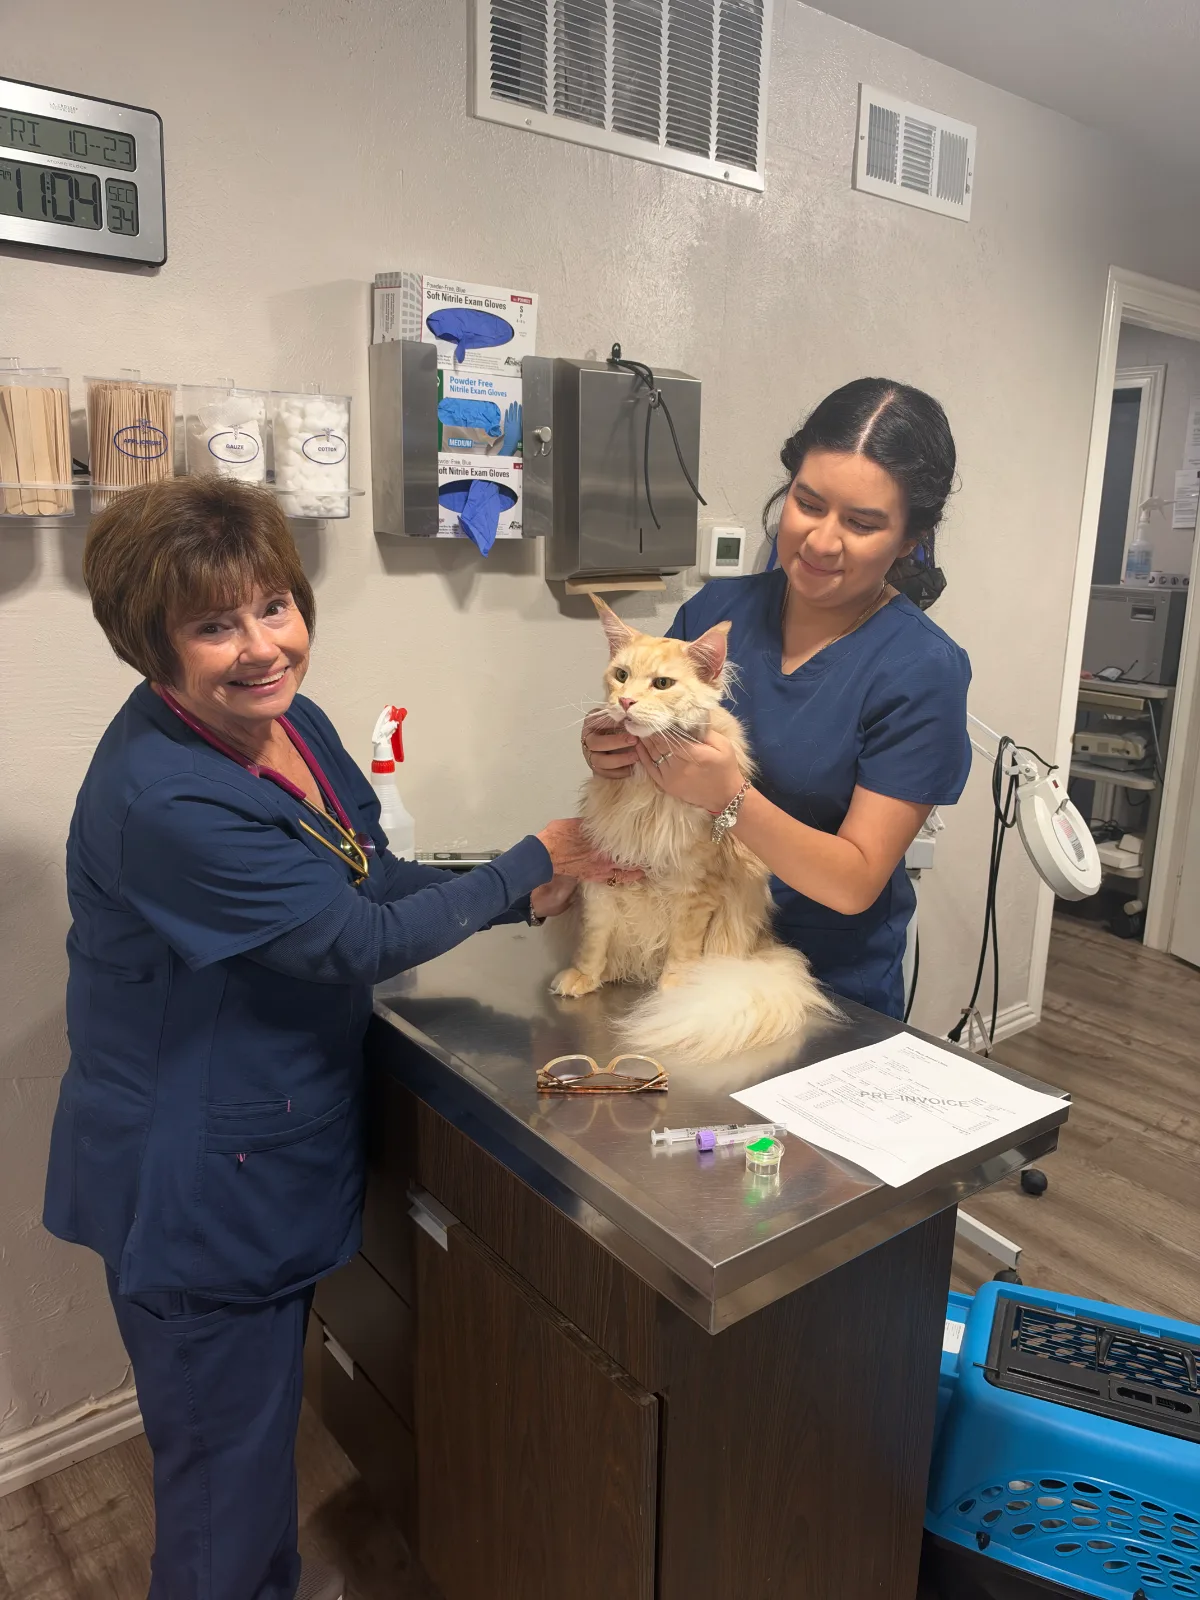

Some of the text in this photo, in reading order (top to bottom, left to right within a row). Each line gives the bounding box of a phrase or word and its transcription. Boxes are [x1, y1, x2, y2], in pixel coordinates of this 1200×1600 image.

[16, 167, 100, 226] 11:04
[108, 185, 135, 205] SEC
[110, 204, 135, 232] 34
[456, 286, 466, 294] Blue
[426, 290, 440, 301] Soft
[441, 292, 463, 304] Nitrile
[464, 296, 483, 308] Exam
[484, 298, 507, 311] Gloves
[449, 375, 493, 388] Powder Free
[449, 384, 507, 398] Nitrile Exam Gloves
[448, 438, 472, 447] MEDIUM
[462, 458, 472, 466] Blue
[438, 466, 510, 478] oft Nitrile Exam Gloves
[860, 1090, 970, 1108] PRE-INVOICE
